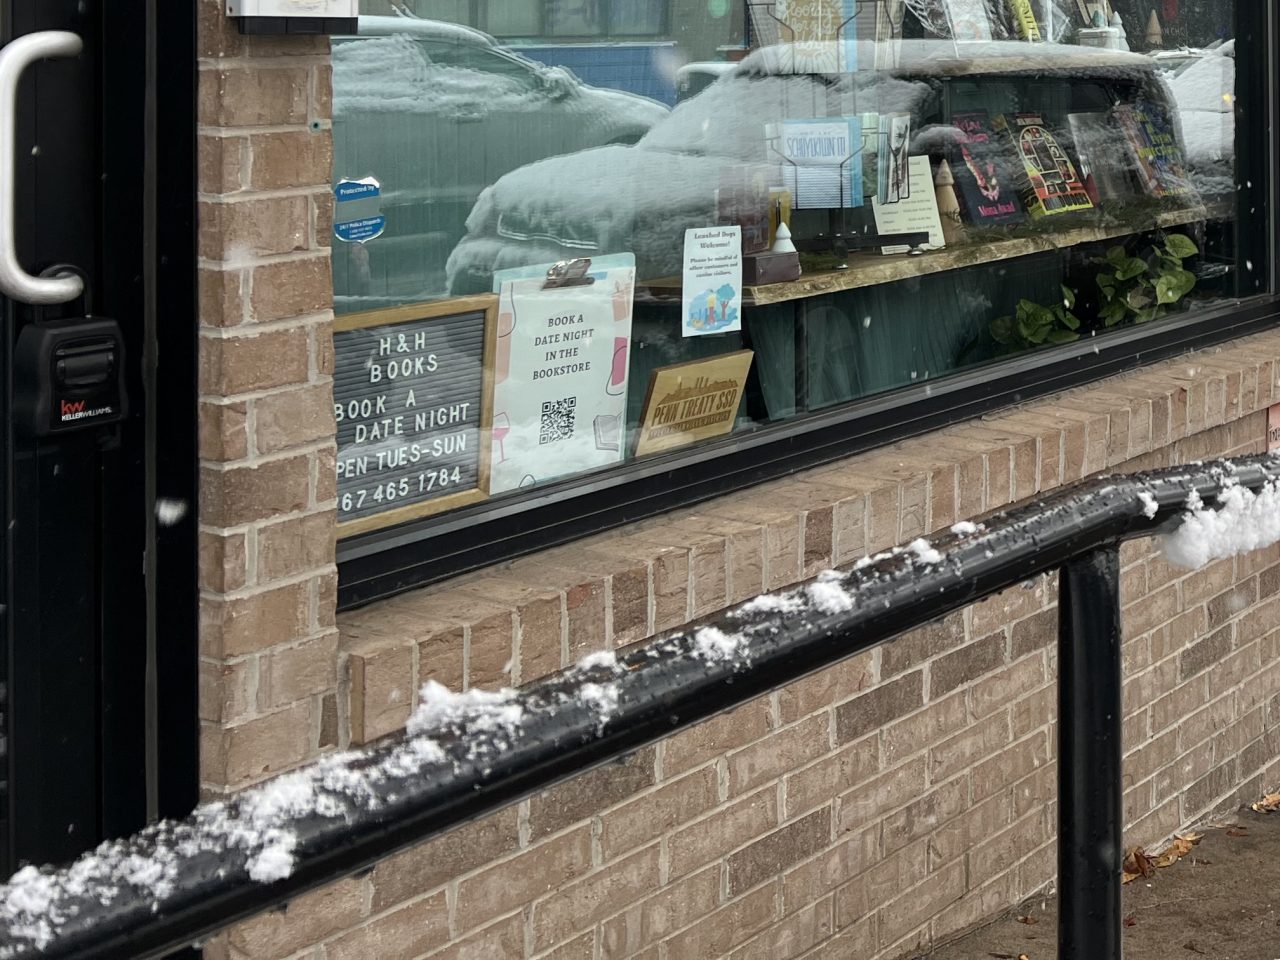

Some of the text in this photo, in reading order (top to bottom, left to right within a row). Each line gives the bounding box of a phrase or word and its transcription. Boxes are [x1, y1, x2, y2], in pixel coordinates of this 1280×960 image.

[694, 230, 736, 240] Leashed Dogs
[700, 240, 730, 249] Welcome!
[547, 313, 584, 329] BOOK A
[534, 328, 594, 347] DATE NIGHT
[545, 347, 578, 361] IN THE
[370, 354, 438, 383] BOOKS
[532, 361, 591, 381] BOOKSTORE
[334, 389, 417, 422] BOOK A
[651, 388, 738, 427] PENN TREATY SSD
[355, 403, 470, 444] DATE NIGHT
[336, 433, 467, 479] PEN TUES-SUN
[341, 466, 461, 512] 67 465 1784
